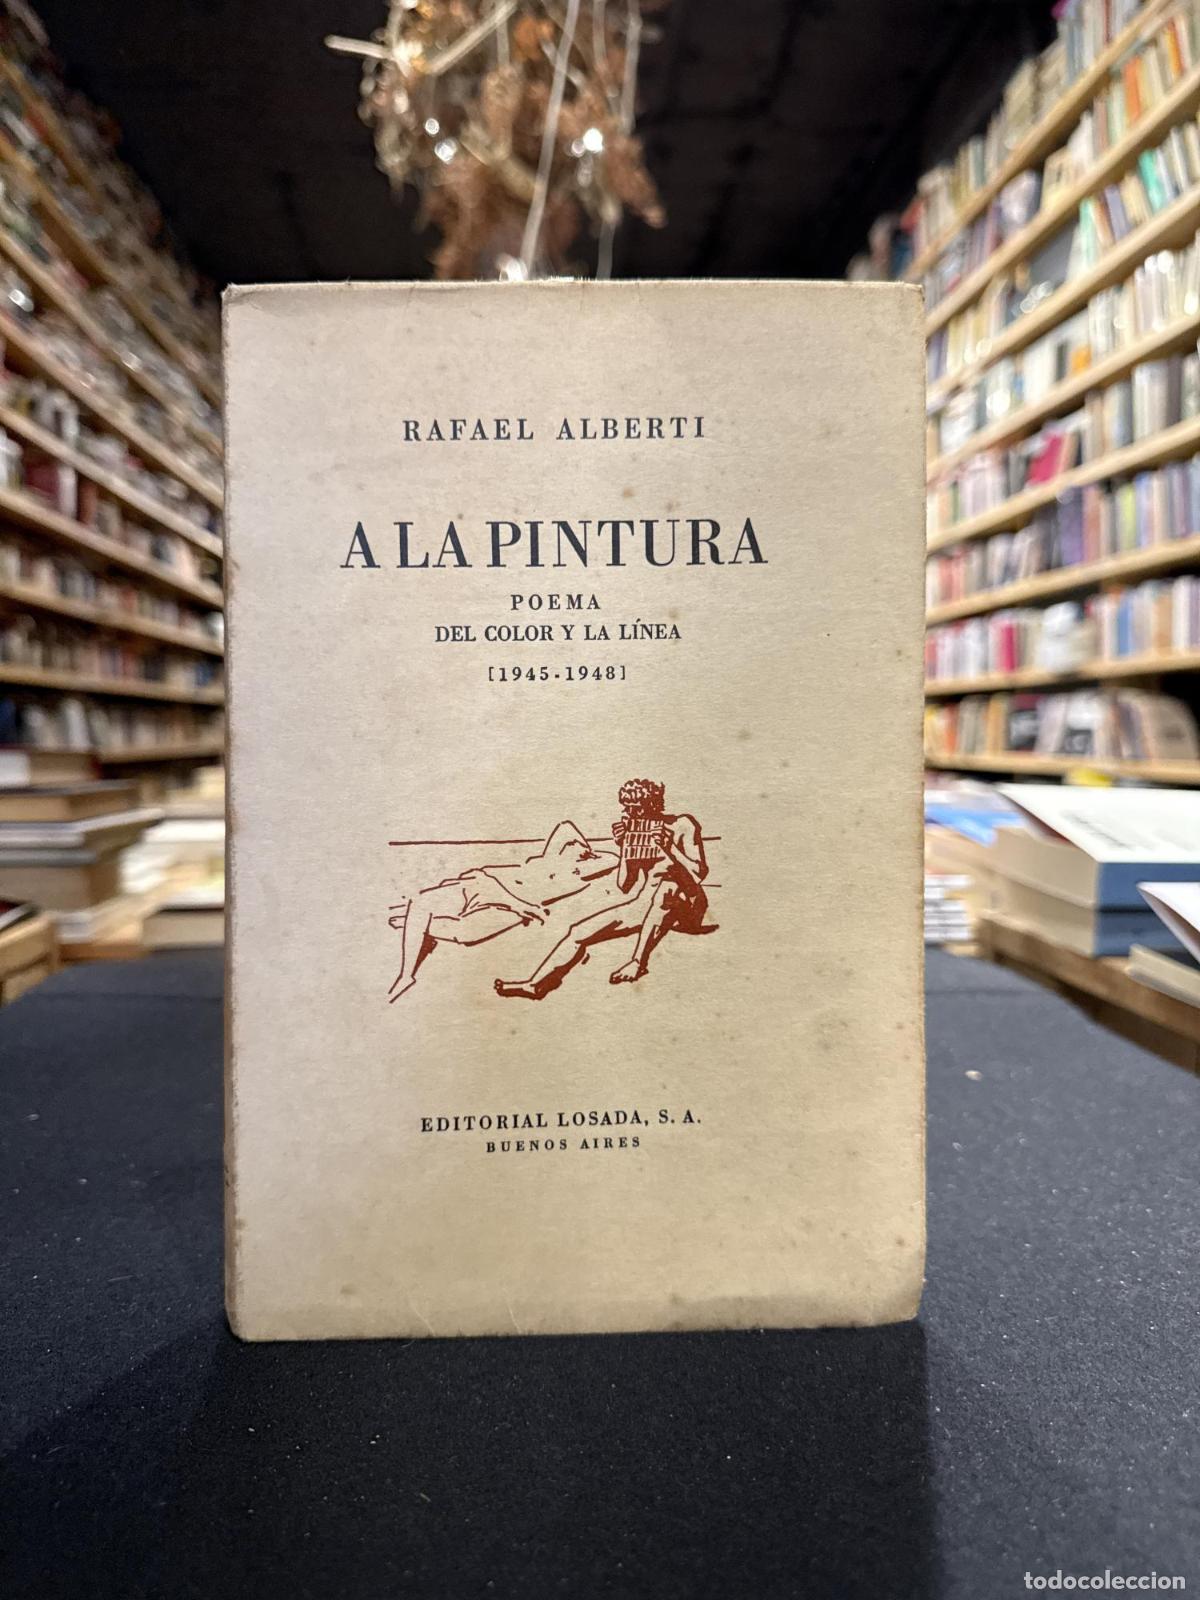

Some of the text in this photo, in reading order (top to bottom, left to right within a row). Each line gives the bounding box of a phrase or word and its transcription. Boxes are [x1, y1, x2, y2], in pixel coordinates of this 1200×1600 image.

[402, 416, 705, 442] RAFAEL ALBERTI
[340, 517, 769, 569] A LA PINTURA
[509, 593, 602, 611] POEMA
[434, 618, 682, 643] DEL COLOR Y LA LÍNEA
[420, 1112, 548, 1133] EDITORIAL
[557, 1109, 649, 1128] LOSADA,
[486, 1136, 640, 1154] BUENOS AIRES
